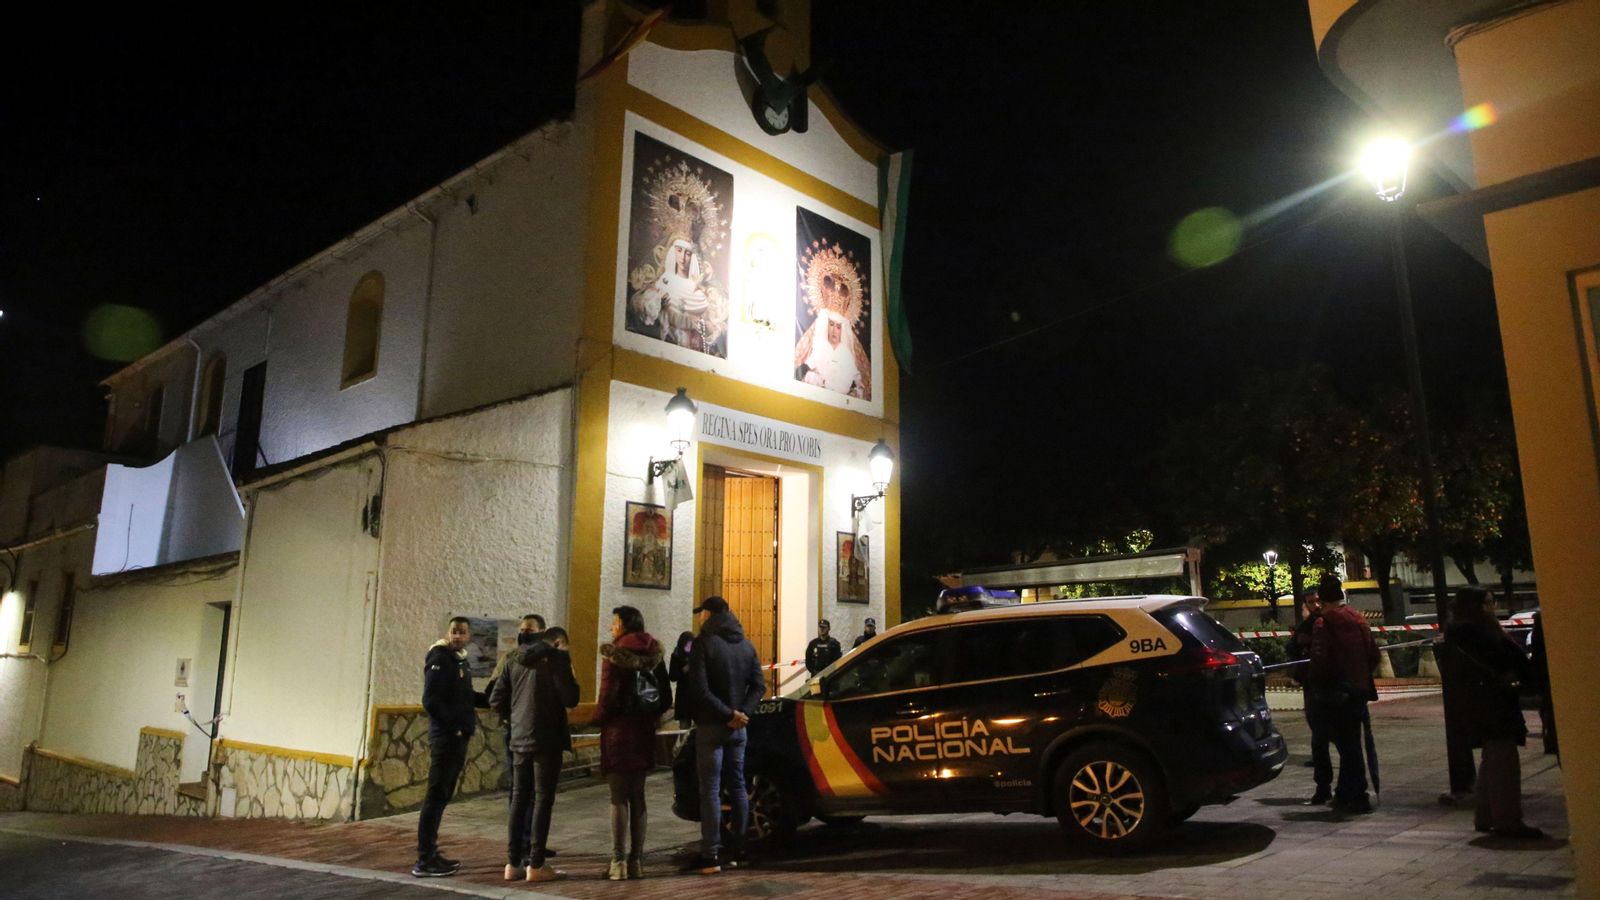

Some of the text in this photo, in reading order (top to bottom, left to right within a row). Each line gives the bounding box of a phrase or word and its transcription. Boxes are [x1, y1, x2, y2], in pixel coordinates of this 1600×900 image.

[702, 413, 822, 458] REGINA SPES ORA PRO NOBIS
[1130, 637, 1167, 653] 9BA
[870, 717, 990, 744] POLICÍA
[872, 737, 1031, 763] NACIONAL
